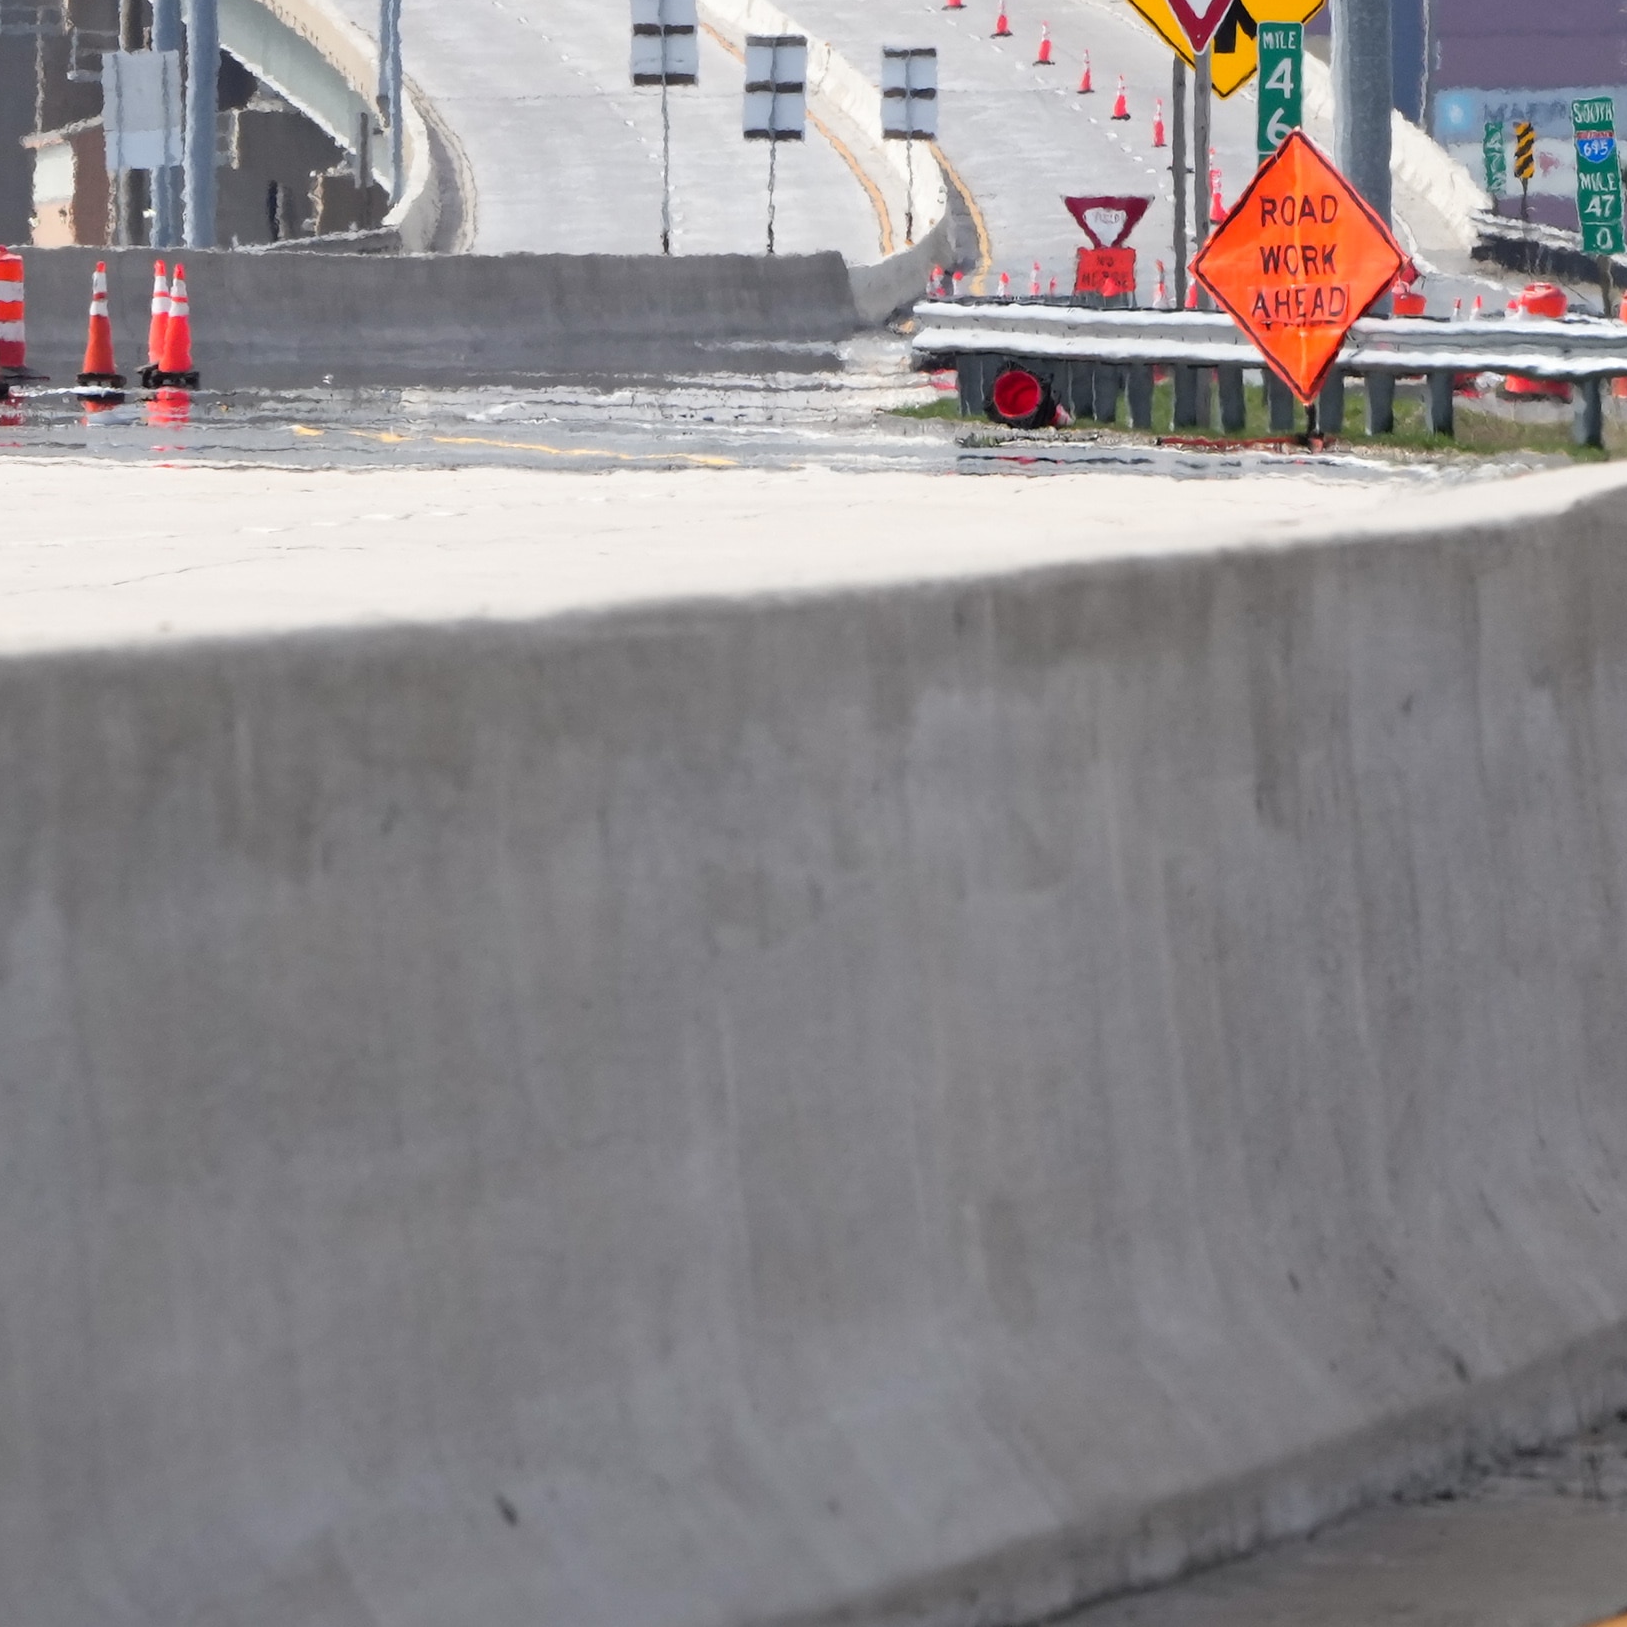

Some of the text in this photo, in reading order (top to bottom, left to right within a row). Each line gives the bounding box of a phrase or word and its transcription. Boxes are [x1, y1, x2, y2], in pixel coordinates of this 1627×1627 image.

[1263, 31, 1297, 49] MILE
[1573, 102, 1614, 123] SOUTH
[1583, 139, 1609, 157] 695
[1580, 173, 1618, 191] MILE
[1260, 195, 1339, 227] ROAD
[1584, 195, 1615, 217] 47
[1259, 244, 1338, 276] WORK
[1252, 286, 1346, 319] AHEAD
